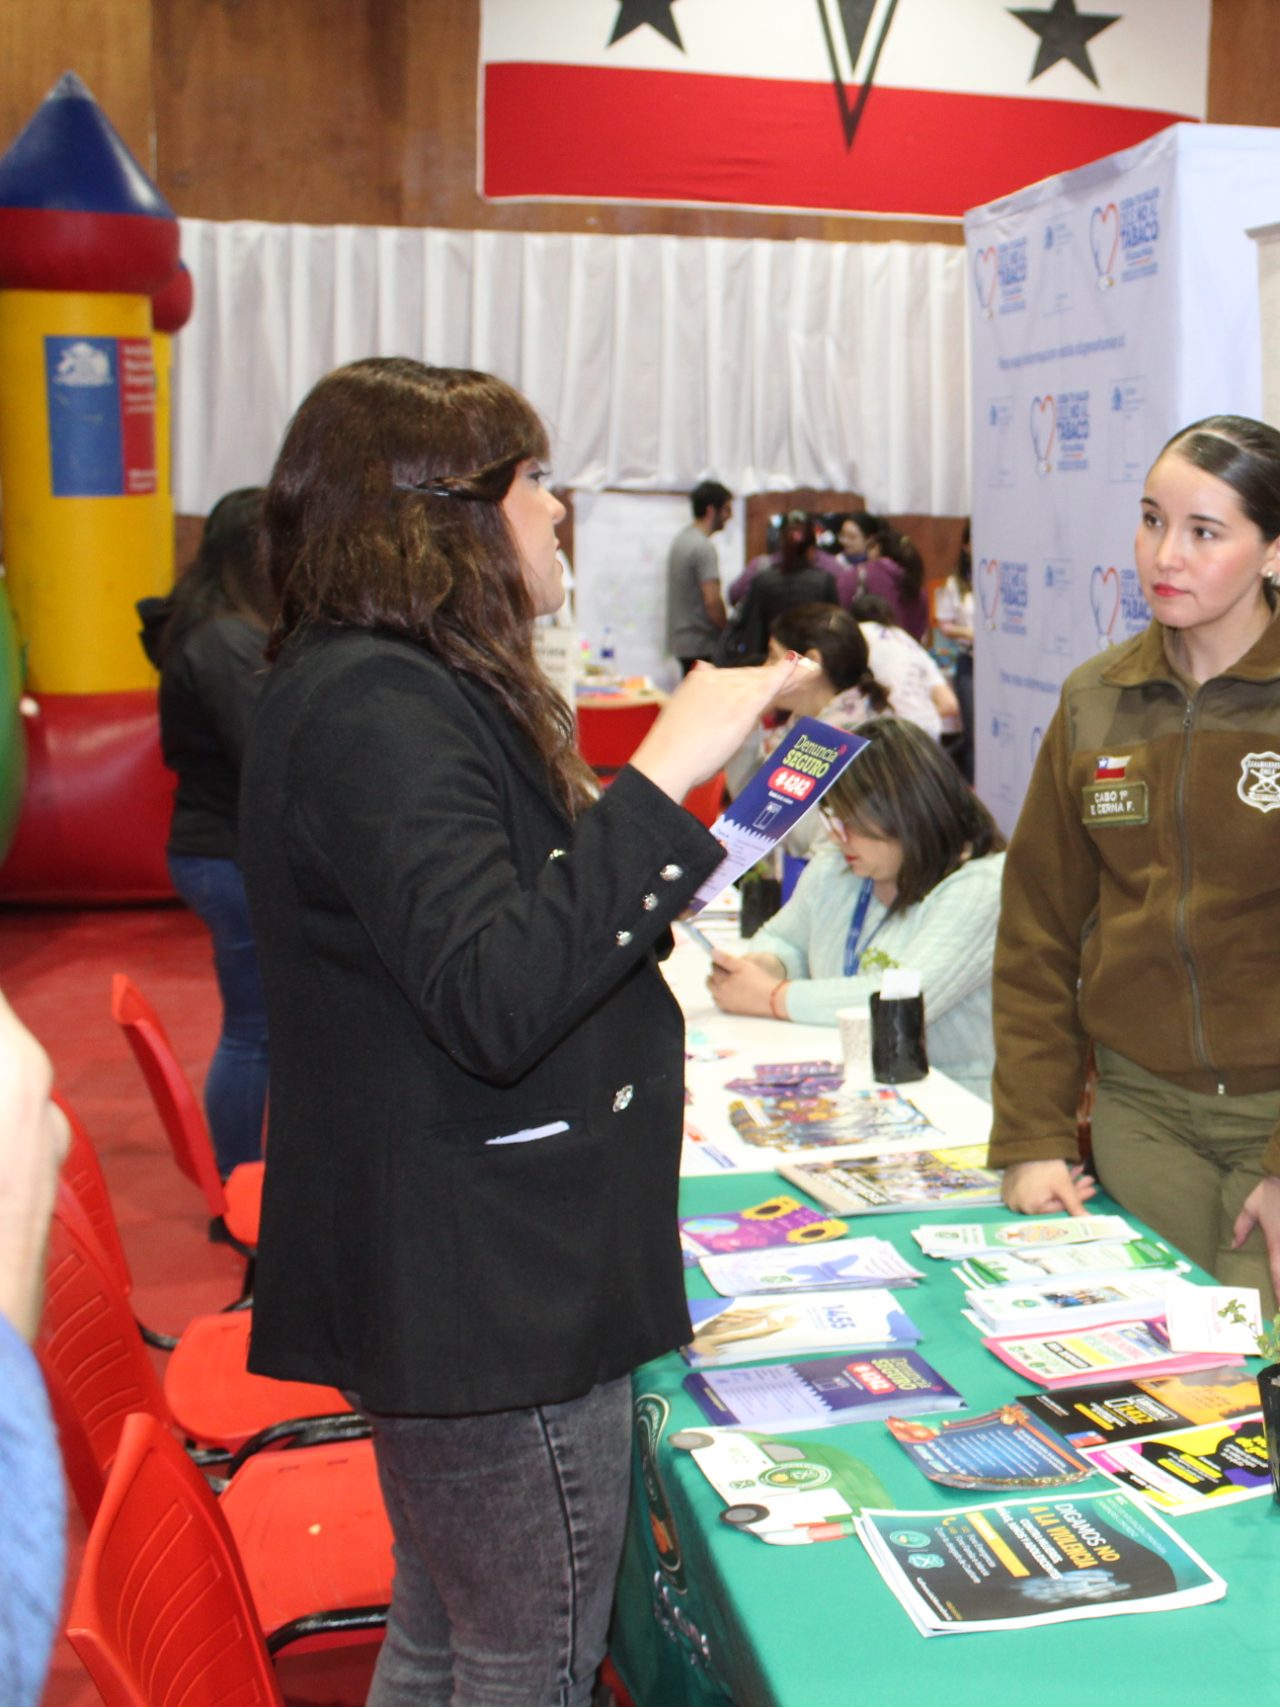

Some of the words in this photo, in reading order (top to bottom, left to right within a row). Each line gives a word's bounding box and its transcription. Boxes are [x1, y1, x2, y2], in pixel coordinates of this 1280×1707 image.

[1120, 220, 1158, 249] TABACO
[794, 734, 838, 763] Denuncia
[782, 749, 831, 779] SEGURO
[1094, 790, 1117, 803] CABO
[1096, 801, 1124, 815] CERNA
[871, 1358, 918, 1391] SEGURO
[1027, 1505, 1049, 1514] A
[1034, 1513, 1060, 1527] LA
[1053, 1502, 1107, 1547] DIGAMOS
[1093, 1545, 1121, 1562] NO
[1046, 1525, 1099, 1569] VIOLENCIA
